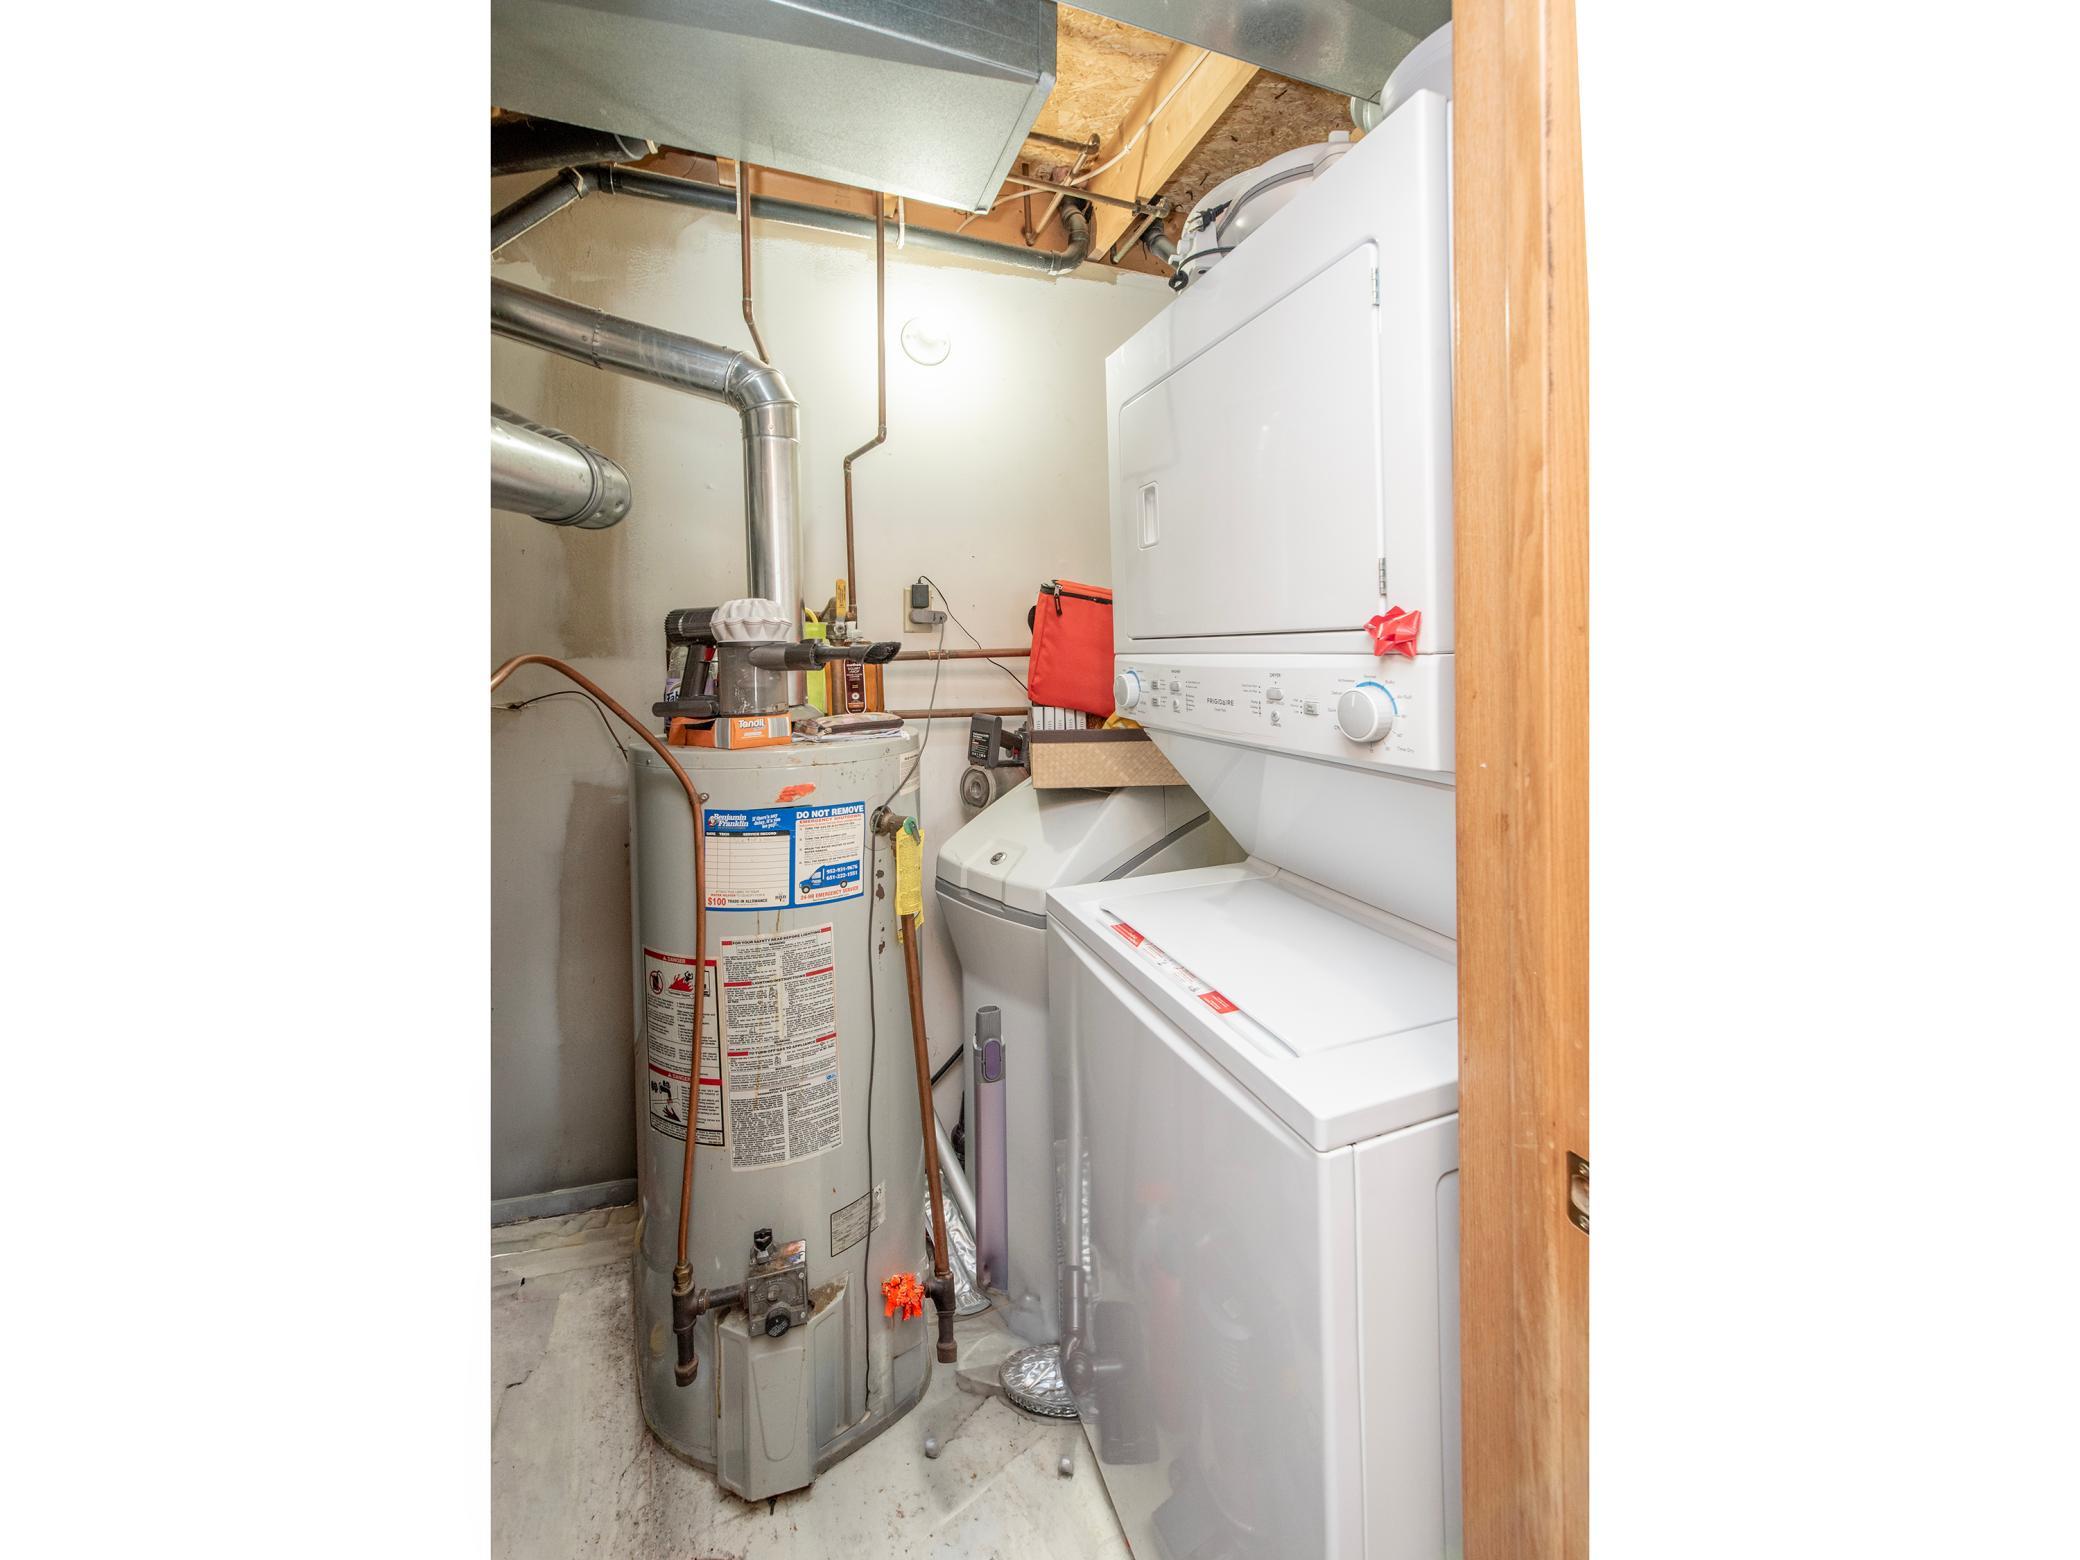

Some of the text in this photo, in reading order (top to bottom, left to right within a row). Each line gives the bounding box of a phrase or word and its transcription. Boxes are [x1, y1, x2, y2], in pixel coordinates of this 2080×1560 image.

[1206, 697, 1235, 706] FRIGIDAIRE
[796, 805, 864, 819] DO NOT REMOVE
[714, 813, 747, 821] Benjamin
[718, 820, 749, 828] Franklin
[707, 896, 727, 906] $100
